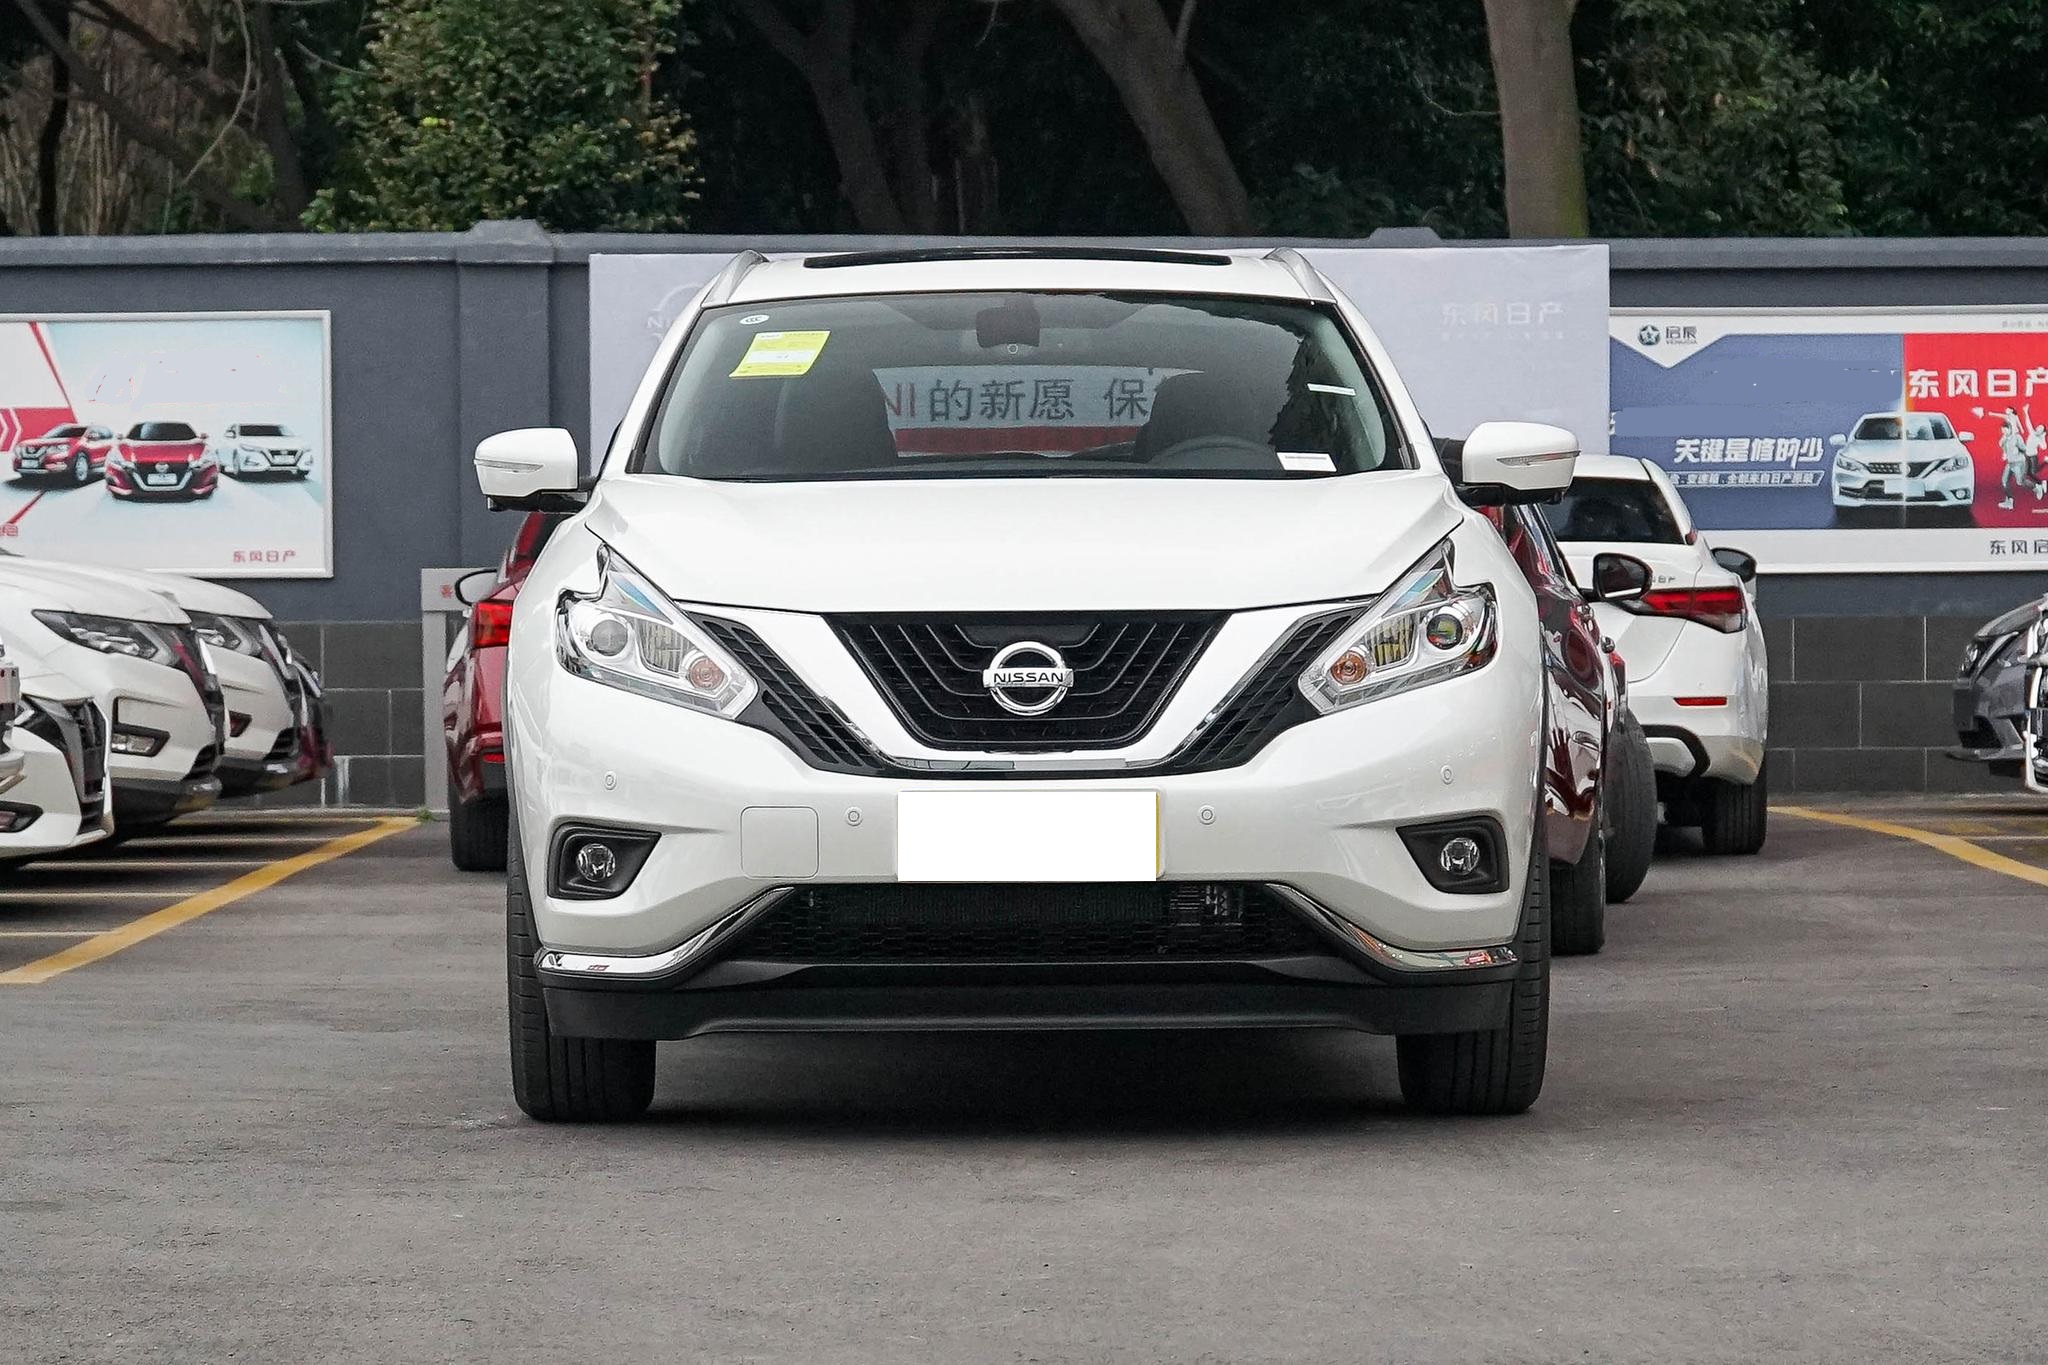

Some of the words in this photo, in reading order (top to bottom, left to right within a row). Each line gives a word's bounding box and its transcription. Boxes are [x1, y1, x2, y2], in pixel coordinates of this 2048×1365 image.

[1907, 366, 2048, 398] 东风日产
[929, 378, 1075, 421] 的新愿
[993, 672, 1064, 683] NISSAN
